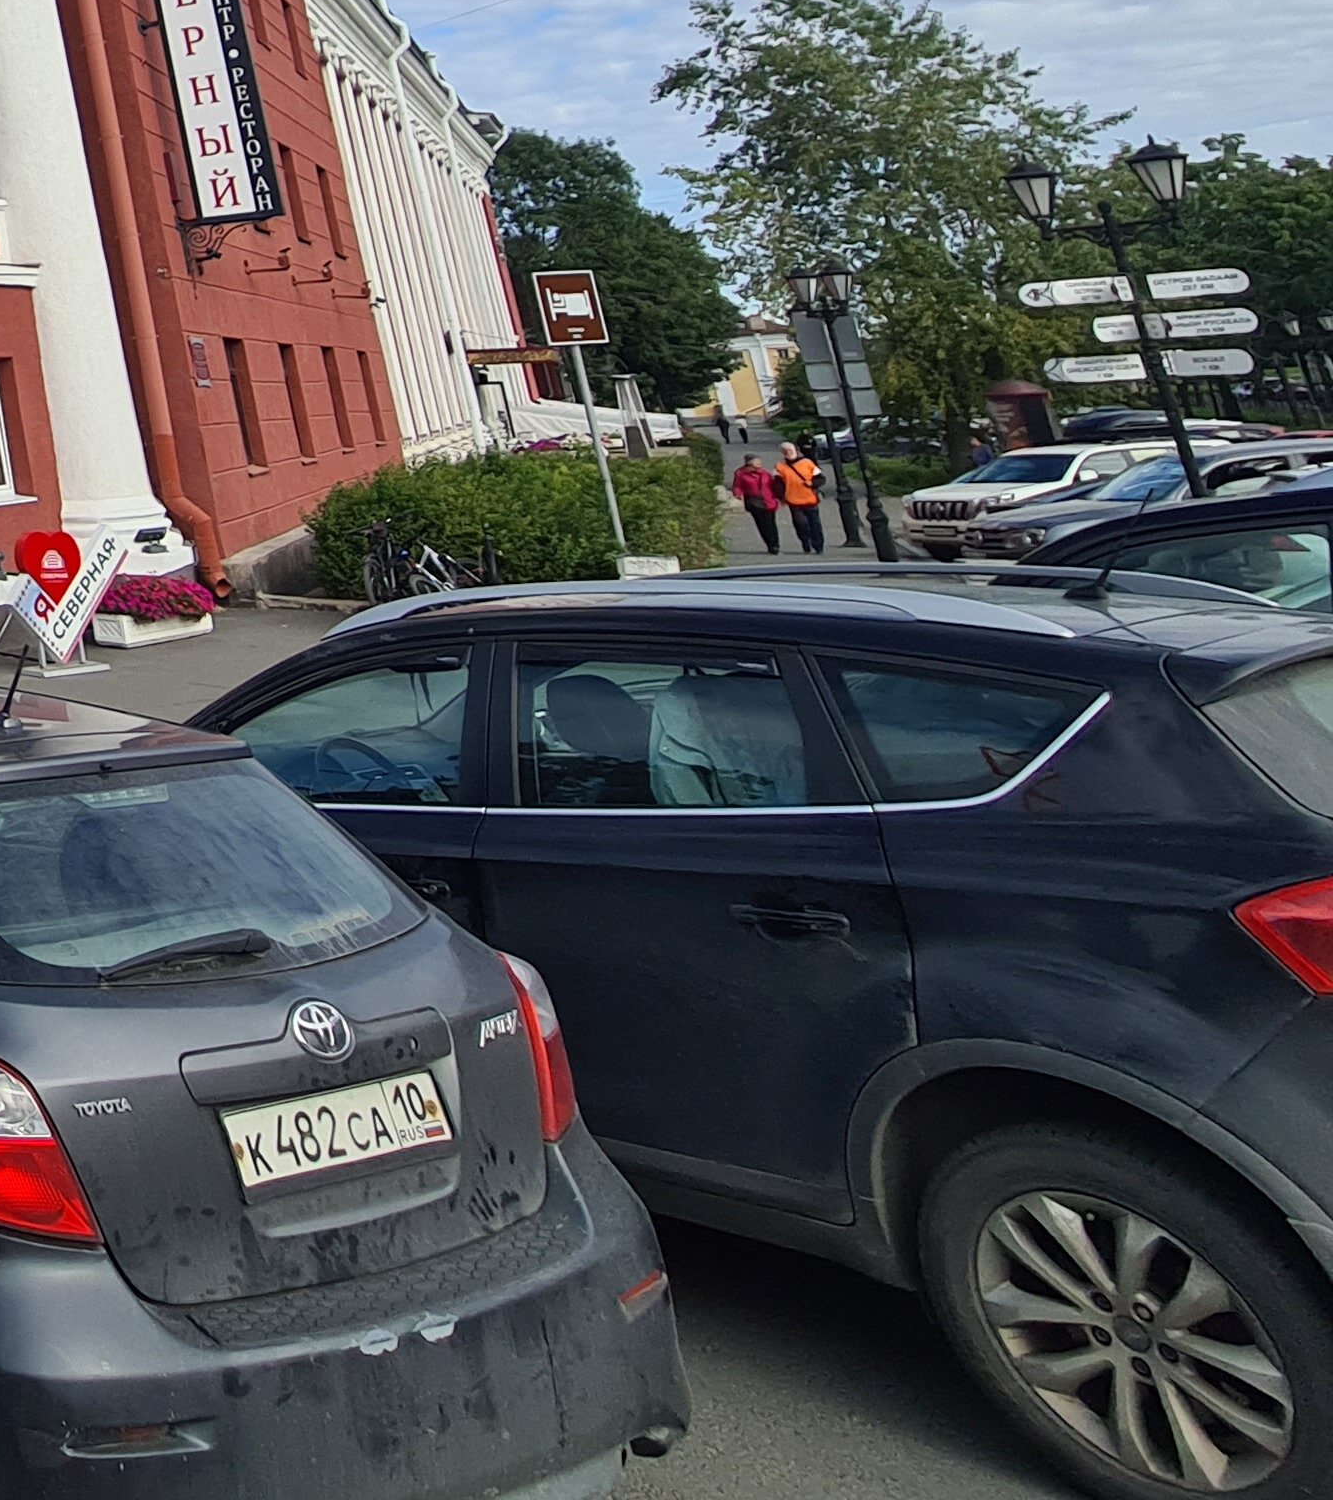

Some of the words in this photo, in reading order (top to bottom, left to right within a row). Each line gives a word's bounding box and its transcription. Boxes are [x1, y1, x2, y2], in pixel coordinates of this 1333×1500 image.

[231, 67, 274, 211] РЕСТОРАН
[52, 537, 116, 640] СЕВЕРНАЯ
[74, 1097, 133, 1117] TOYOTA
[245, 1106, 395, 1177] К482СА
[393, 1082, 427, 1124] 10
[400, 1126, 425, 1142] RUS
